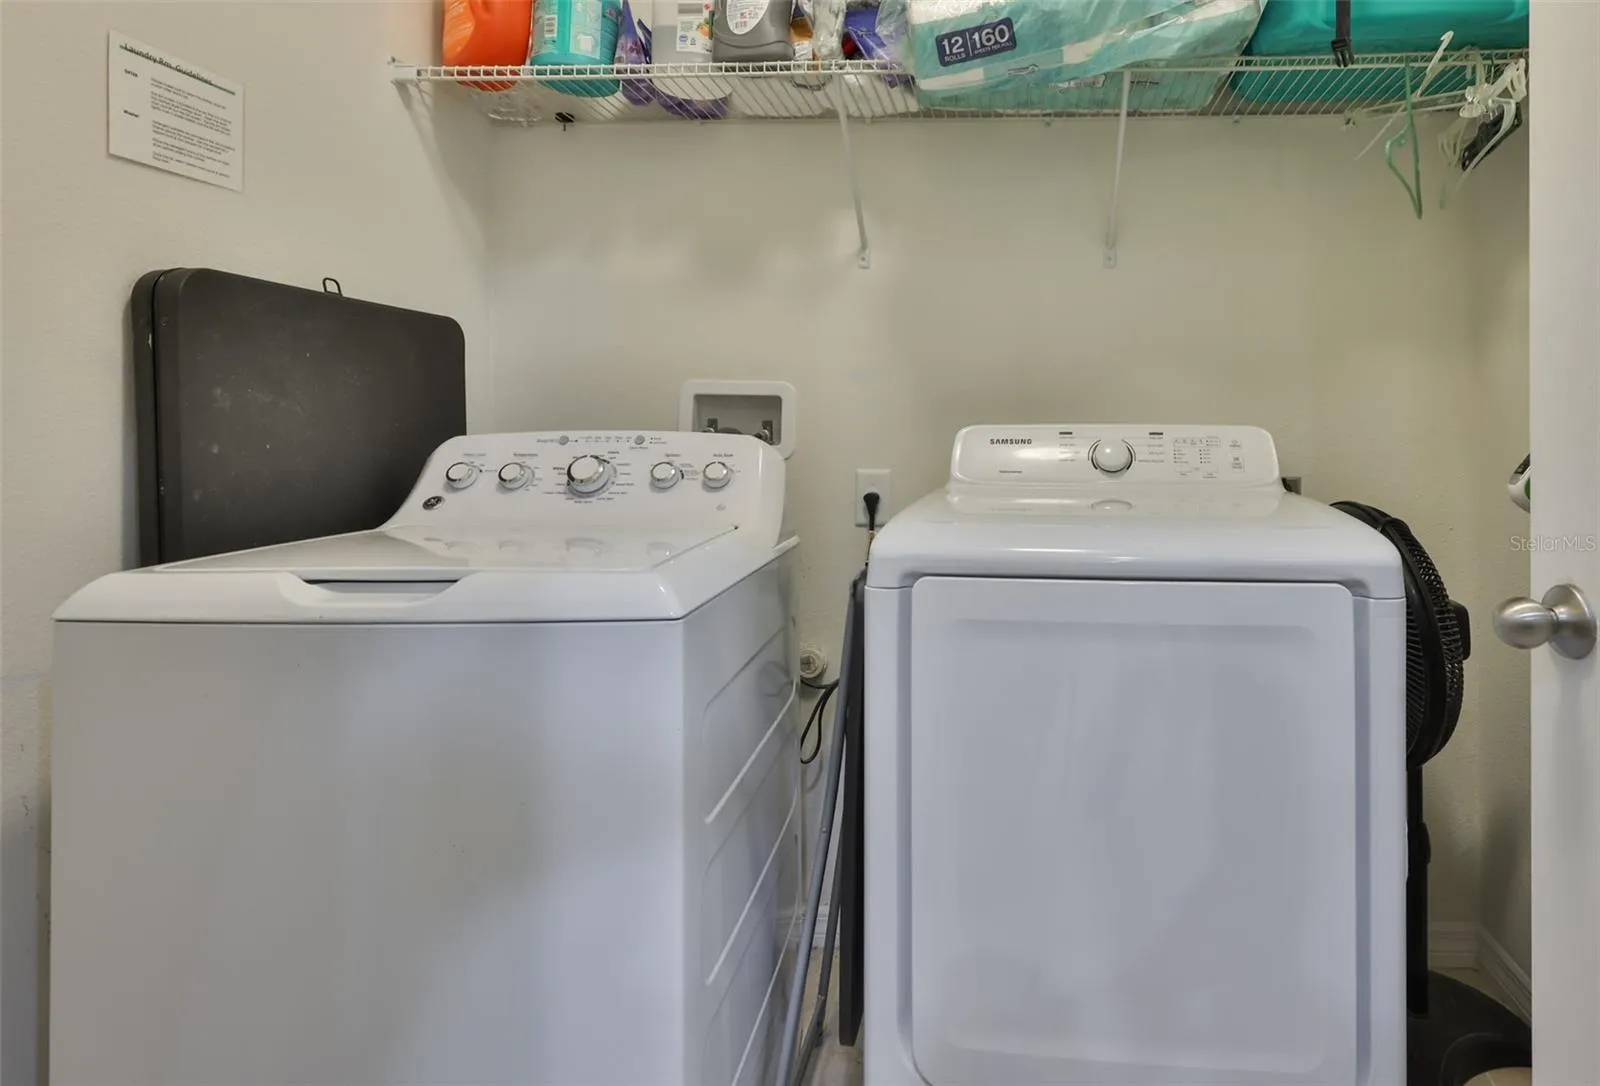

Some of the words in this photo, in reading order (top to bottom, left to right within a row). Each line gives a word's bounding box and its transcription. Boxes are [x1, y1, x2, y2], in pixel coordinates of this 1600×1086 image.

[942, 36, 964, 55] 12
[972, 24, 1009, 49] 160
[944, 53, 966, 62] ROLLS
